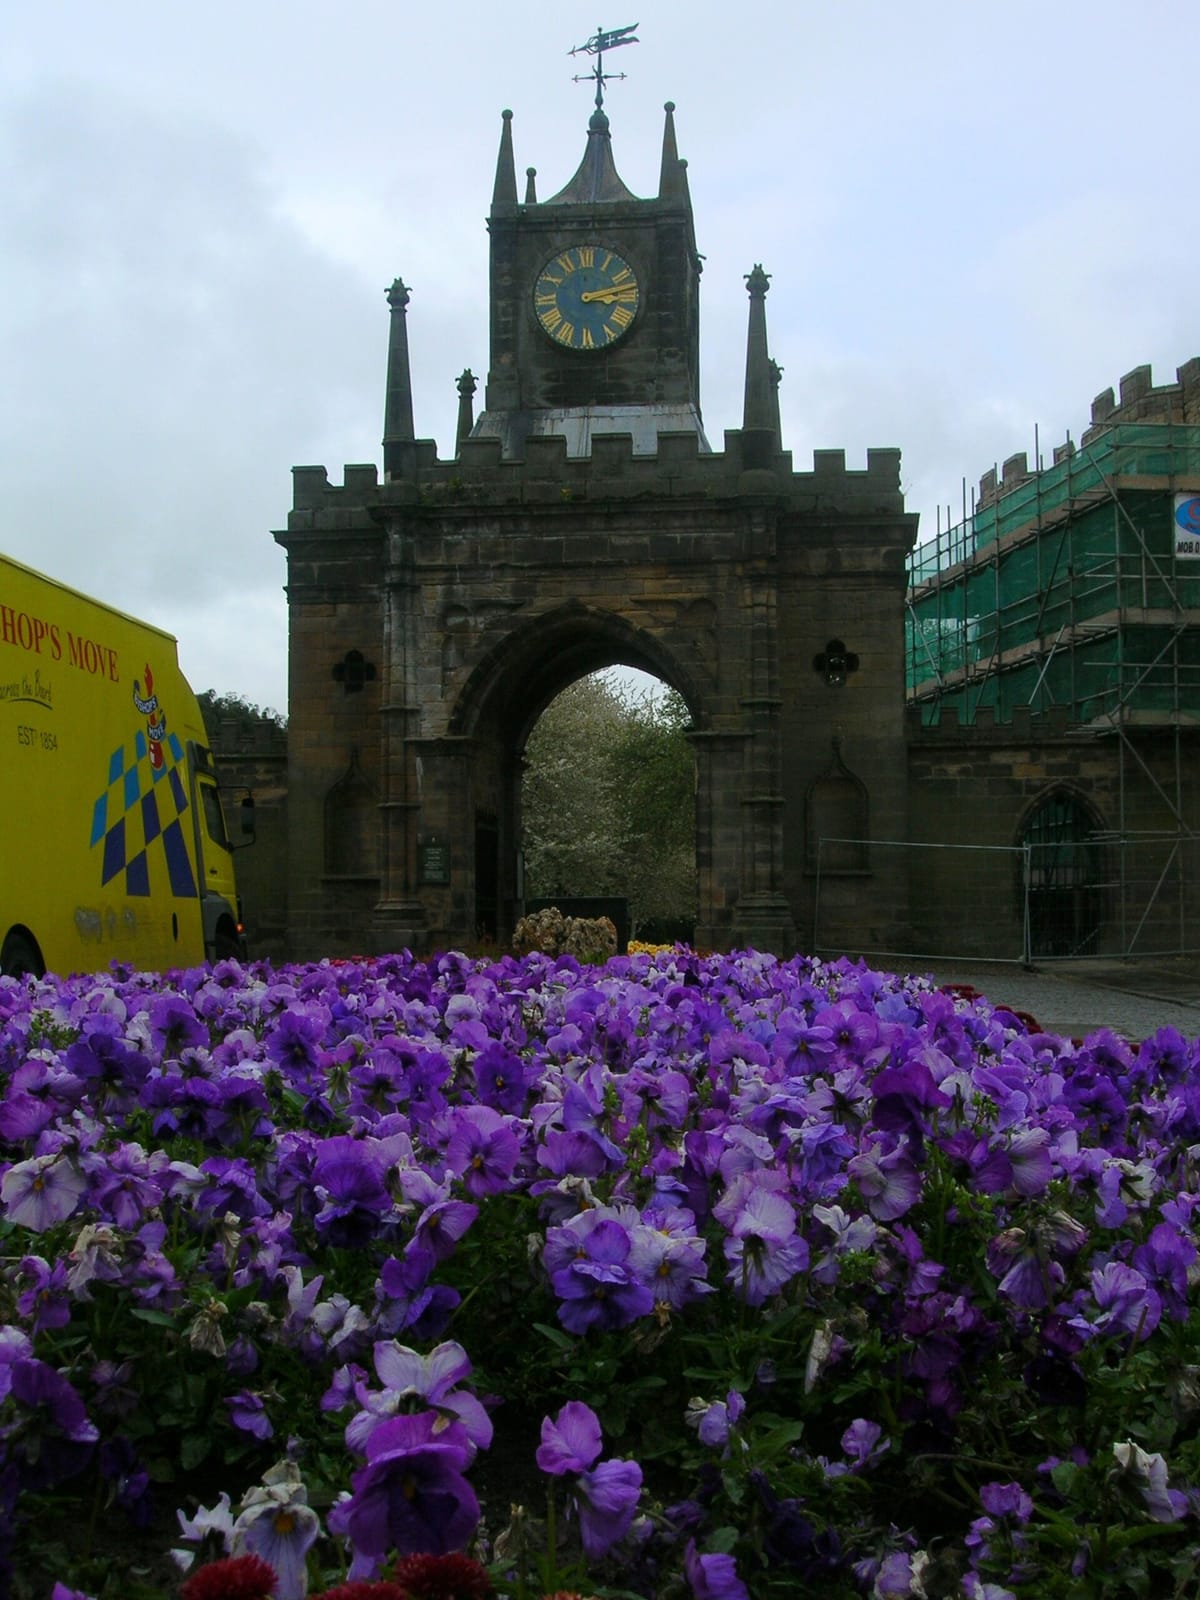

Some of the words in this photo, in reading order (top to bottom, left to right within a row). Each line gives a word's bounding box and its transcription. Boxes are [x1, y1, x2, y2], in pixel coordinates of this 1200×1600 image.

[1177, 541, 1193, 553] MOB
[0, 604, 62, 660] HOP'S
[66, 632, 120, 683] MOVE
